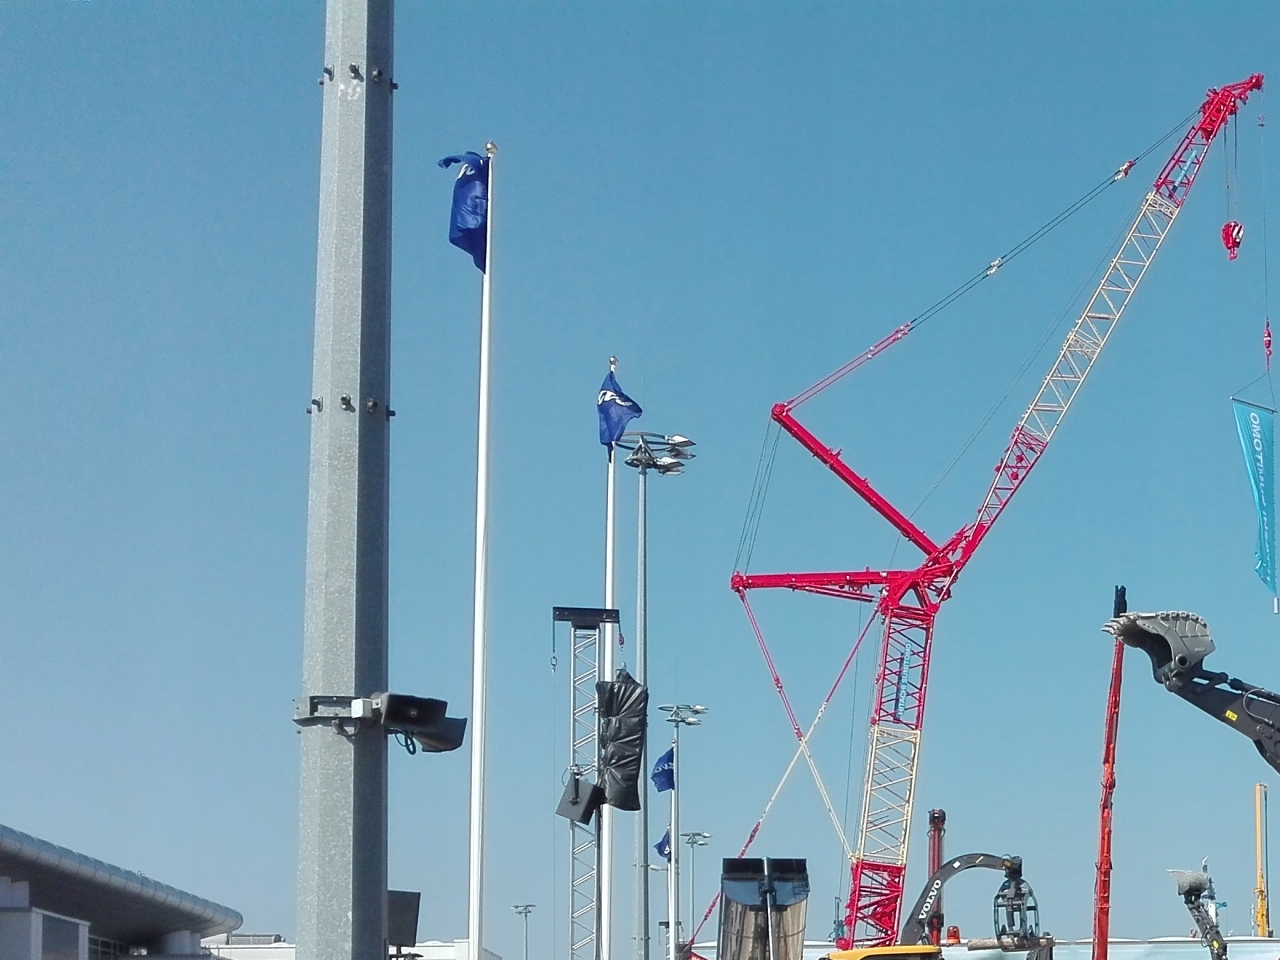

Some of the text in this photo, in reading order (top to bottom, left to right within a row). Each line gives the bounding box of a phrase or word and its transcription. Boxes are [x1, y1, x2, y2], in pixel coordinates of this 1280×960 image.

[898, 643, 912, 715] HITACHI SUMITOMO
[918, 879, 942, 919] VOLVO
